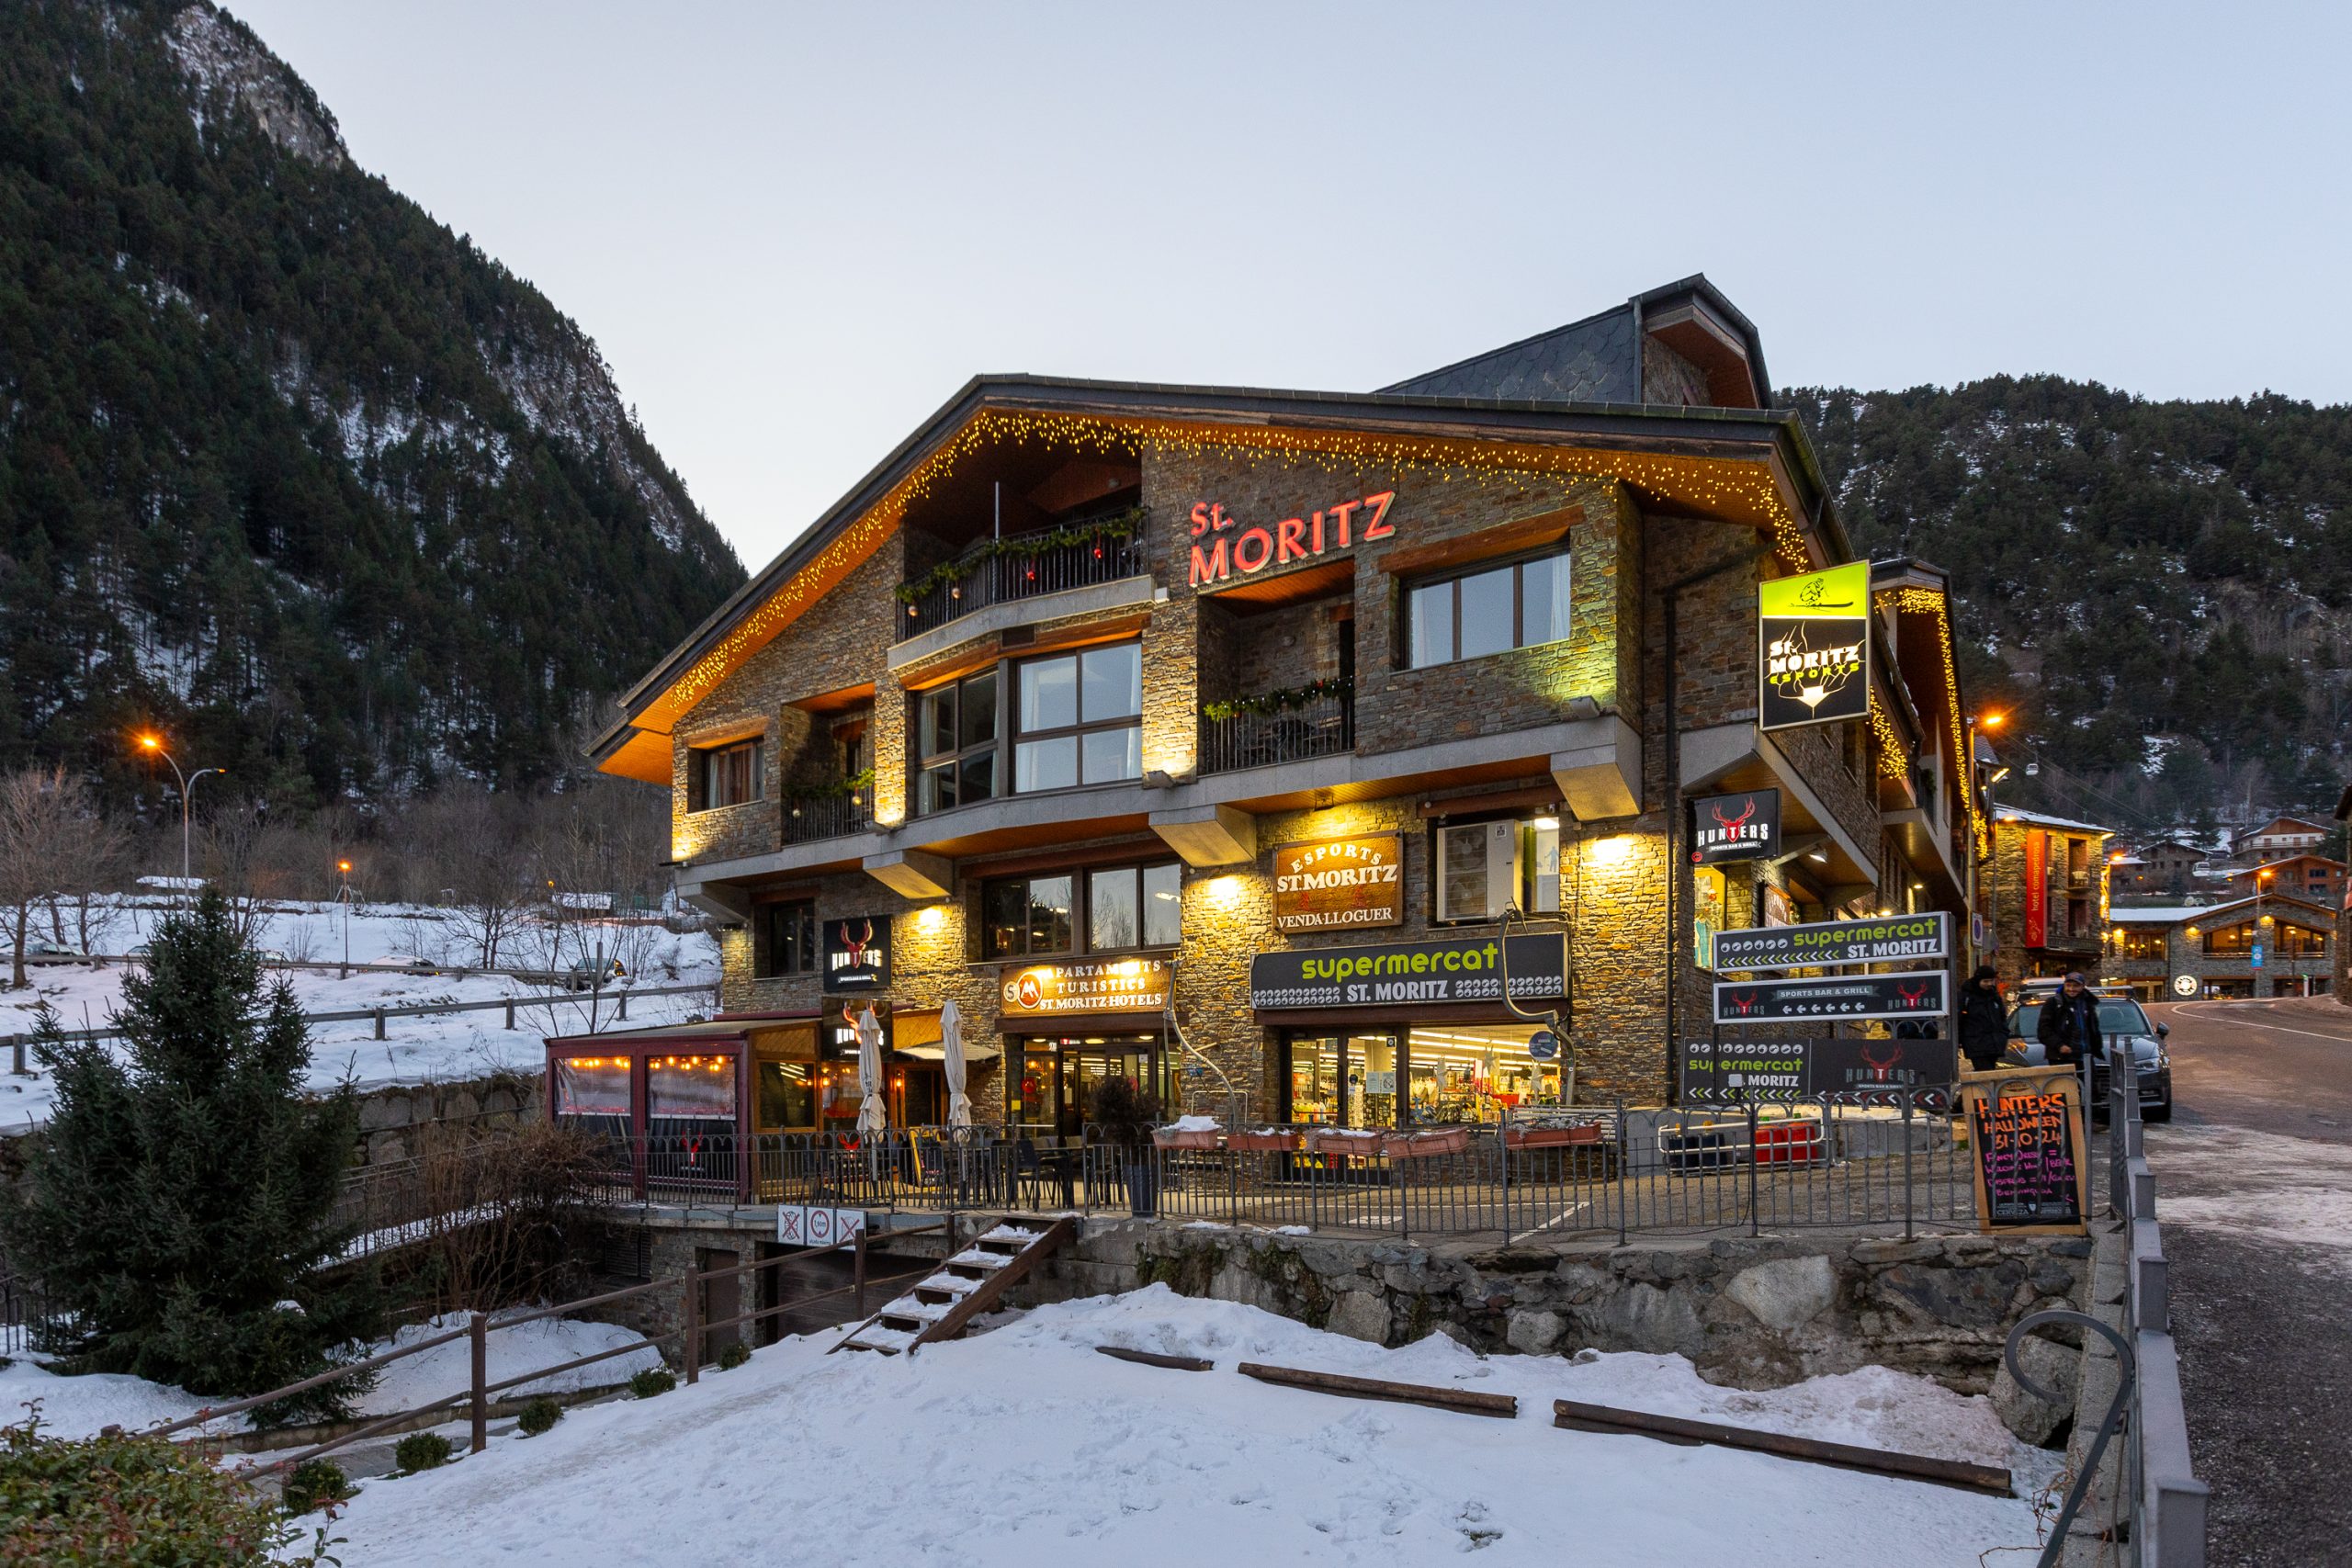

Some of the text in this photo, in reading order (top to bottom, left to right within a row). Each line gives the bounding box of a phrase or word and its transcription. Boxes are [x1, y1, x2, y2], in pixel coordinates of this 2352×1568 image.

[1190, 502, 1236, 537] St.
[1189, 491, 1396, 588] MORITZ
[1770, 640, 1798, 657] St.
[1770, 645, 1859, 674] MORITZ
[1770, 662, 1860, 684] ESPORTS
[1697, 823, 1769, 848] HUNTERS
[1290, 843, 1382, 874] ESPORTS
[1793, 918, 1937, 947] supermercat
[1848, 939, 1938, 959] ST. MORITZ
[831, 949, 883, 972] HUNTERS
[1045, 960, 1161, 979] APARTAMTS
[1301, 942, 1498, 983] supermercat
[1057, 977, 1146, 994] TURISTICS
[1347, 980, 1448, 1002] ST. MORITZ
[1780, 989, 1813, 998] SPORTS
[1843, 987, 1870, 995] GRILL
[1723, 1005, 1765, 1017] HUNTERS
[1887, 998, 1937, 1010] HUNTERS
[836, 1028, 884, 1046] HUNS
[1748, 1075, 1799, 1087] MORITZ
[1846, 1068, 1916, 1085] HUNTERS
